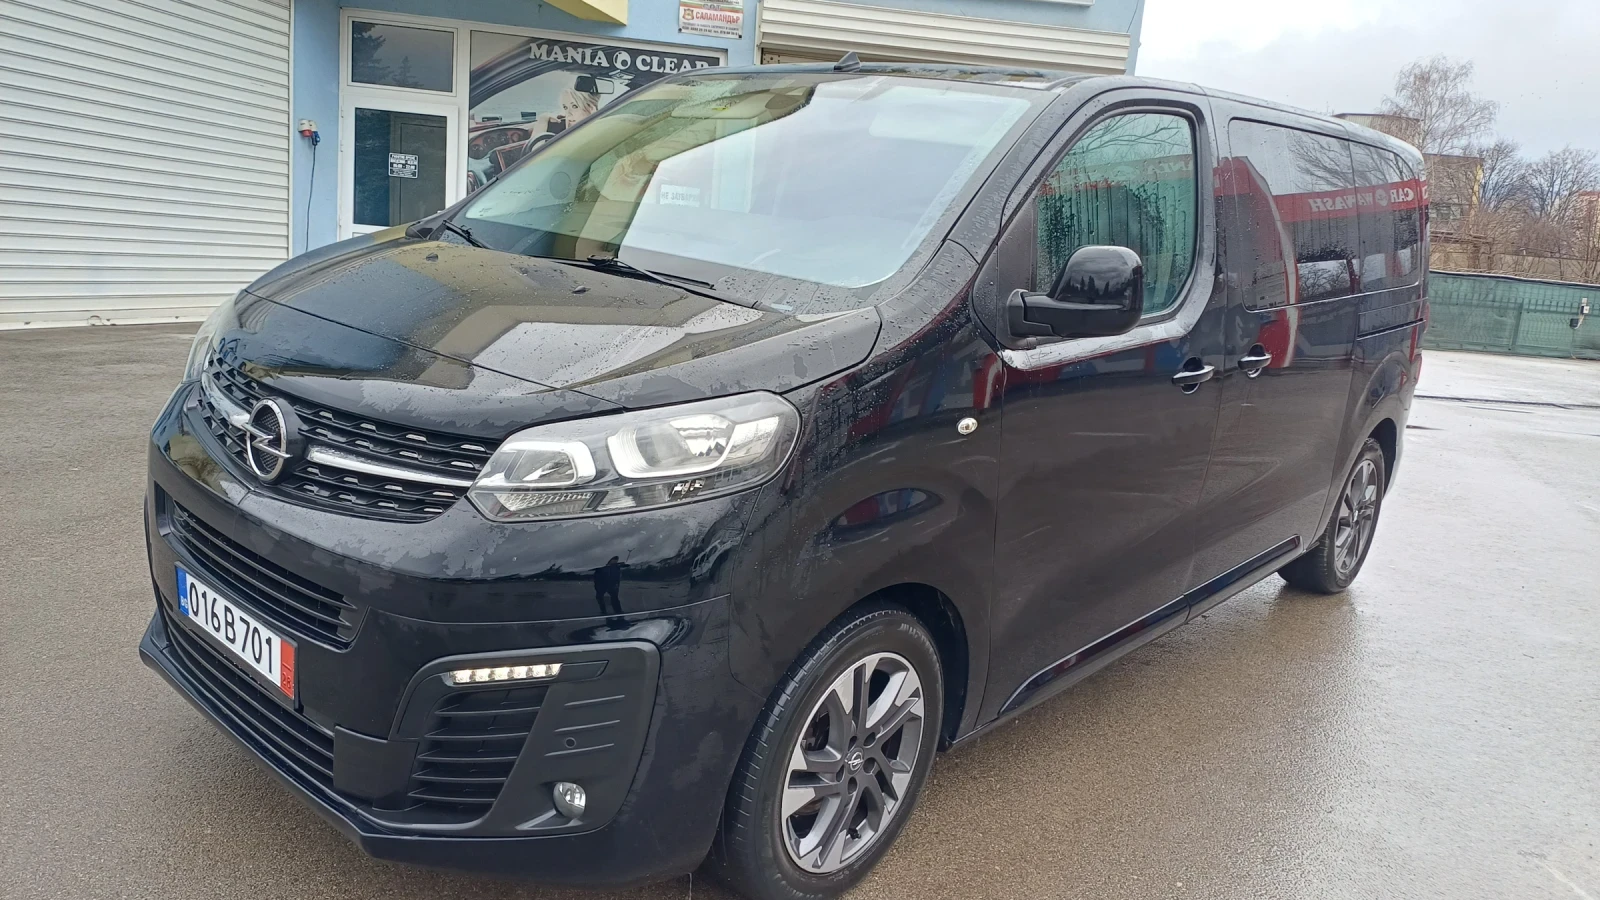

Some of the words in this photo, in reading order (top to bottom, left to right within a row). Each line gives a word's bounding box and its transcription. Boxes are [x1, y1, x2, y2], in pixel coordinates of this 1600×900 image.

[695, 11, 740, 24] САЛАМАНДЪР
[529, 43, 610, 67] MANIA
[189, 581, 273, 675] 016B701
